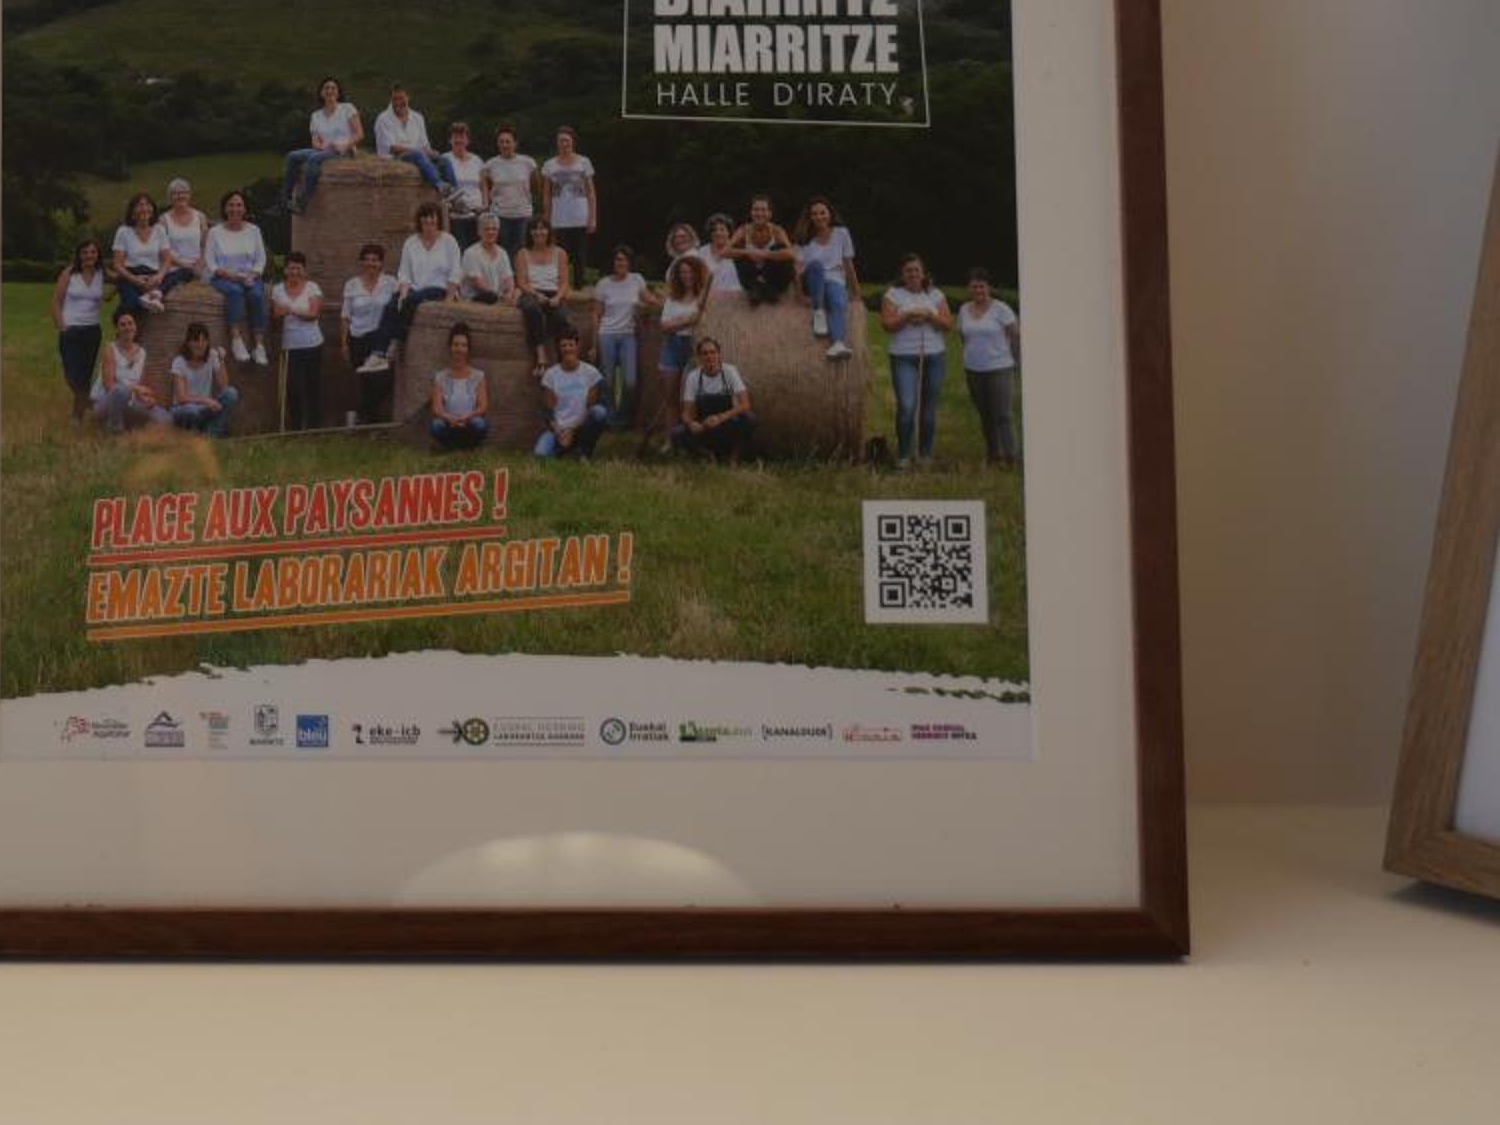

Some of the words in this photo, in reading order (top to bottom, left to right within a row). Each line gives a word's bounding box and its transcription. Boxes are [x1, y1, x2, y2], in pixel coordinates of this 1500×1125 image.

[652, 23, 900, 74] MIARRITZE
[656, 81, 751, 107] HALLE
[772, 81, 897, 107] D'IRATY
[90, 490, 197, 549] PLACE
[204, 484, 280, 541] AUX
[282, 472, 486, 537] PAYSANNES
[490, 468, 510, 519] !
[85, 563, 229, 624] EMAZTE
[232, 546, 449, 612] LABORARIAK
[453, 536, 610, 596] ARGITAN
[616, 532, 634, 583] !
